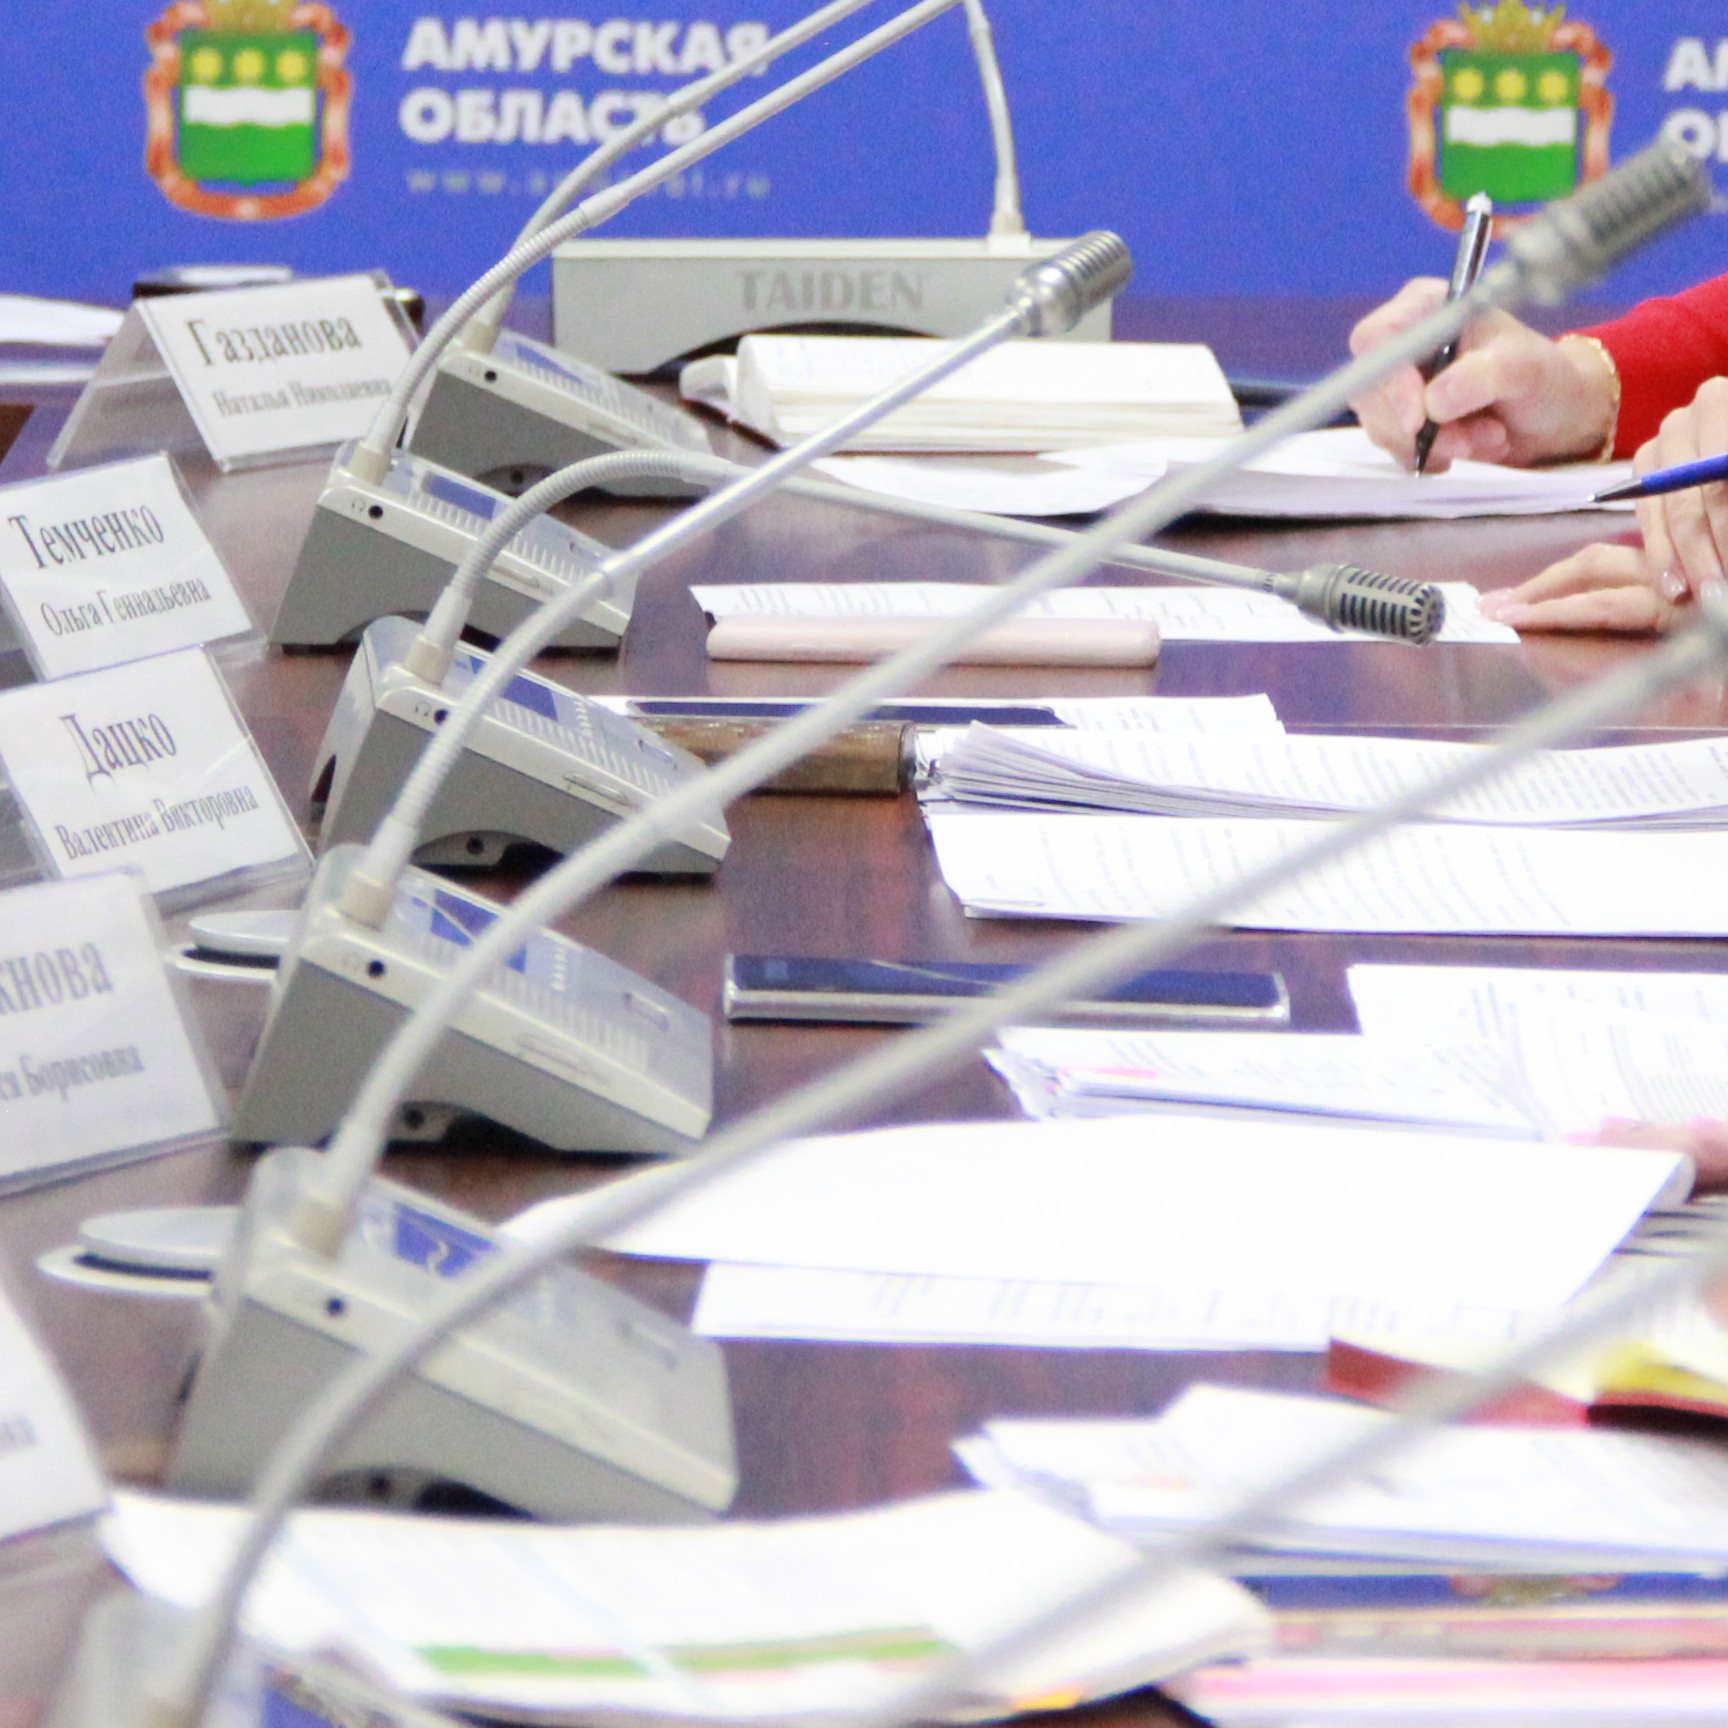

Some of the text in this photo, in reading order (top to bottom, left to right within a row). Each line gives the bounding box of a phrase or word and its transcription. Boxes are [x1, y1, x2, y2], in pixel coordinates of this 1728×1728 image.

[401, 17, 772, 76] АМУРСКАЯ
[732, 270, 924, 312] TAIDEN
[184, 316, 363, 367] Газданова
[8, 504, 165, 570] Темченко
[39, 578, 212, 636] Ольга Геннадьевна
[57, 712, 178, 793] Дацко
[54, 785, 261, 861] Валентина Викторовна
